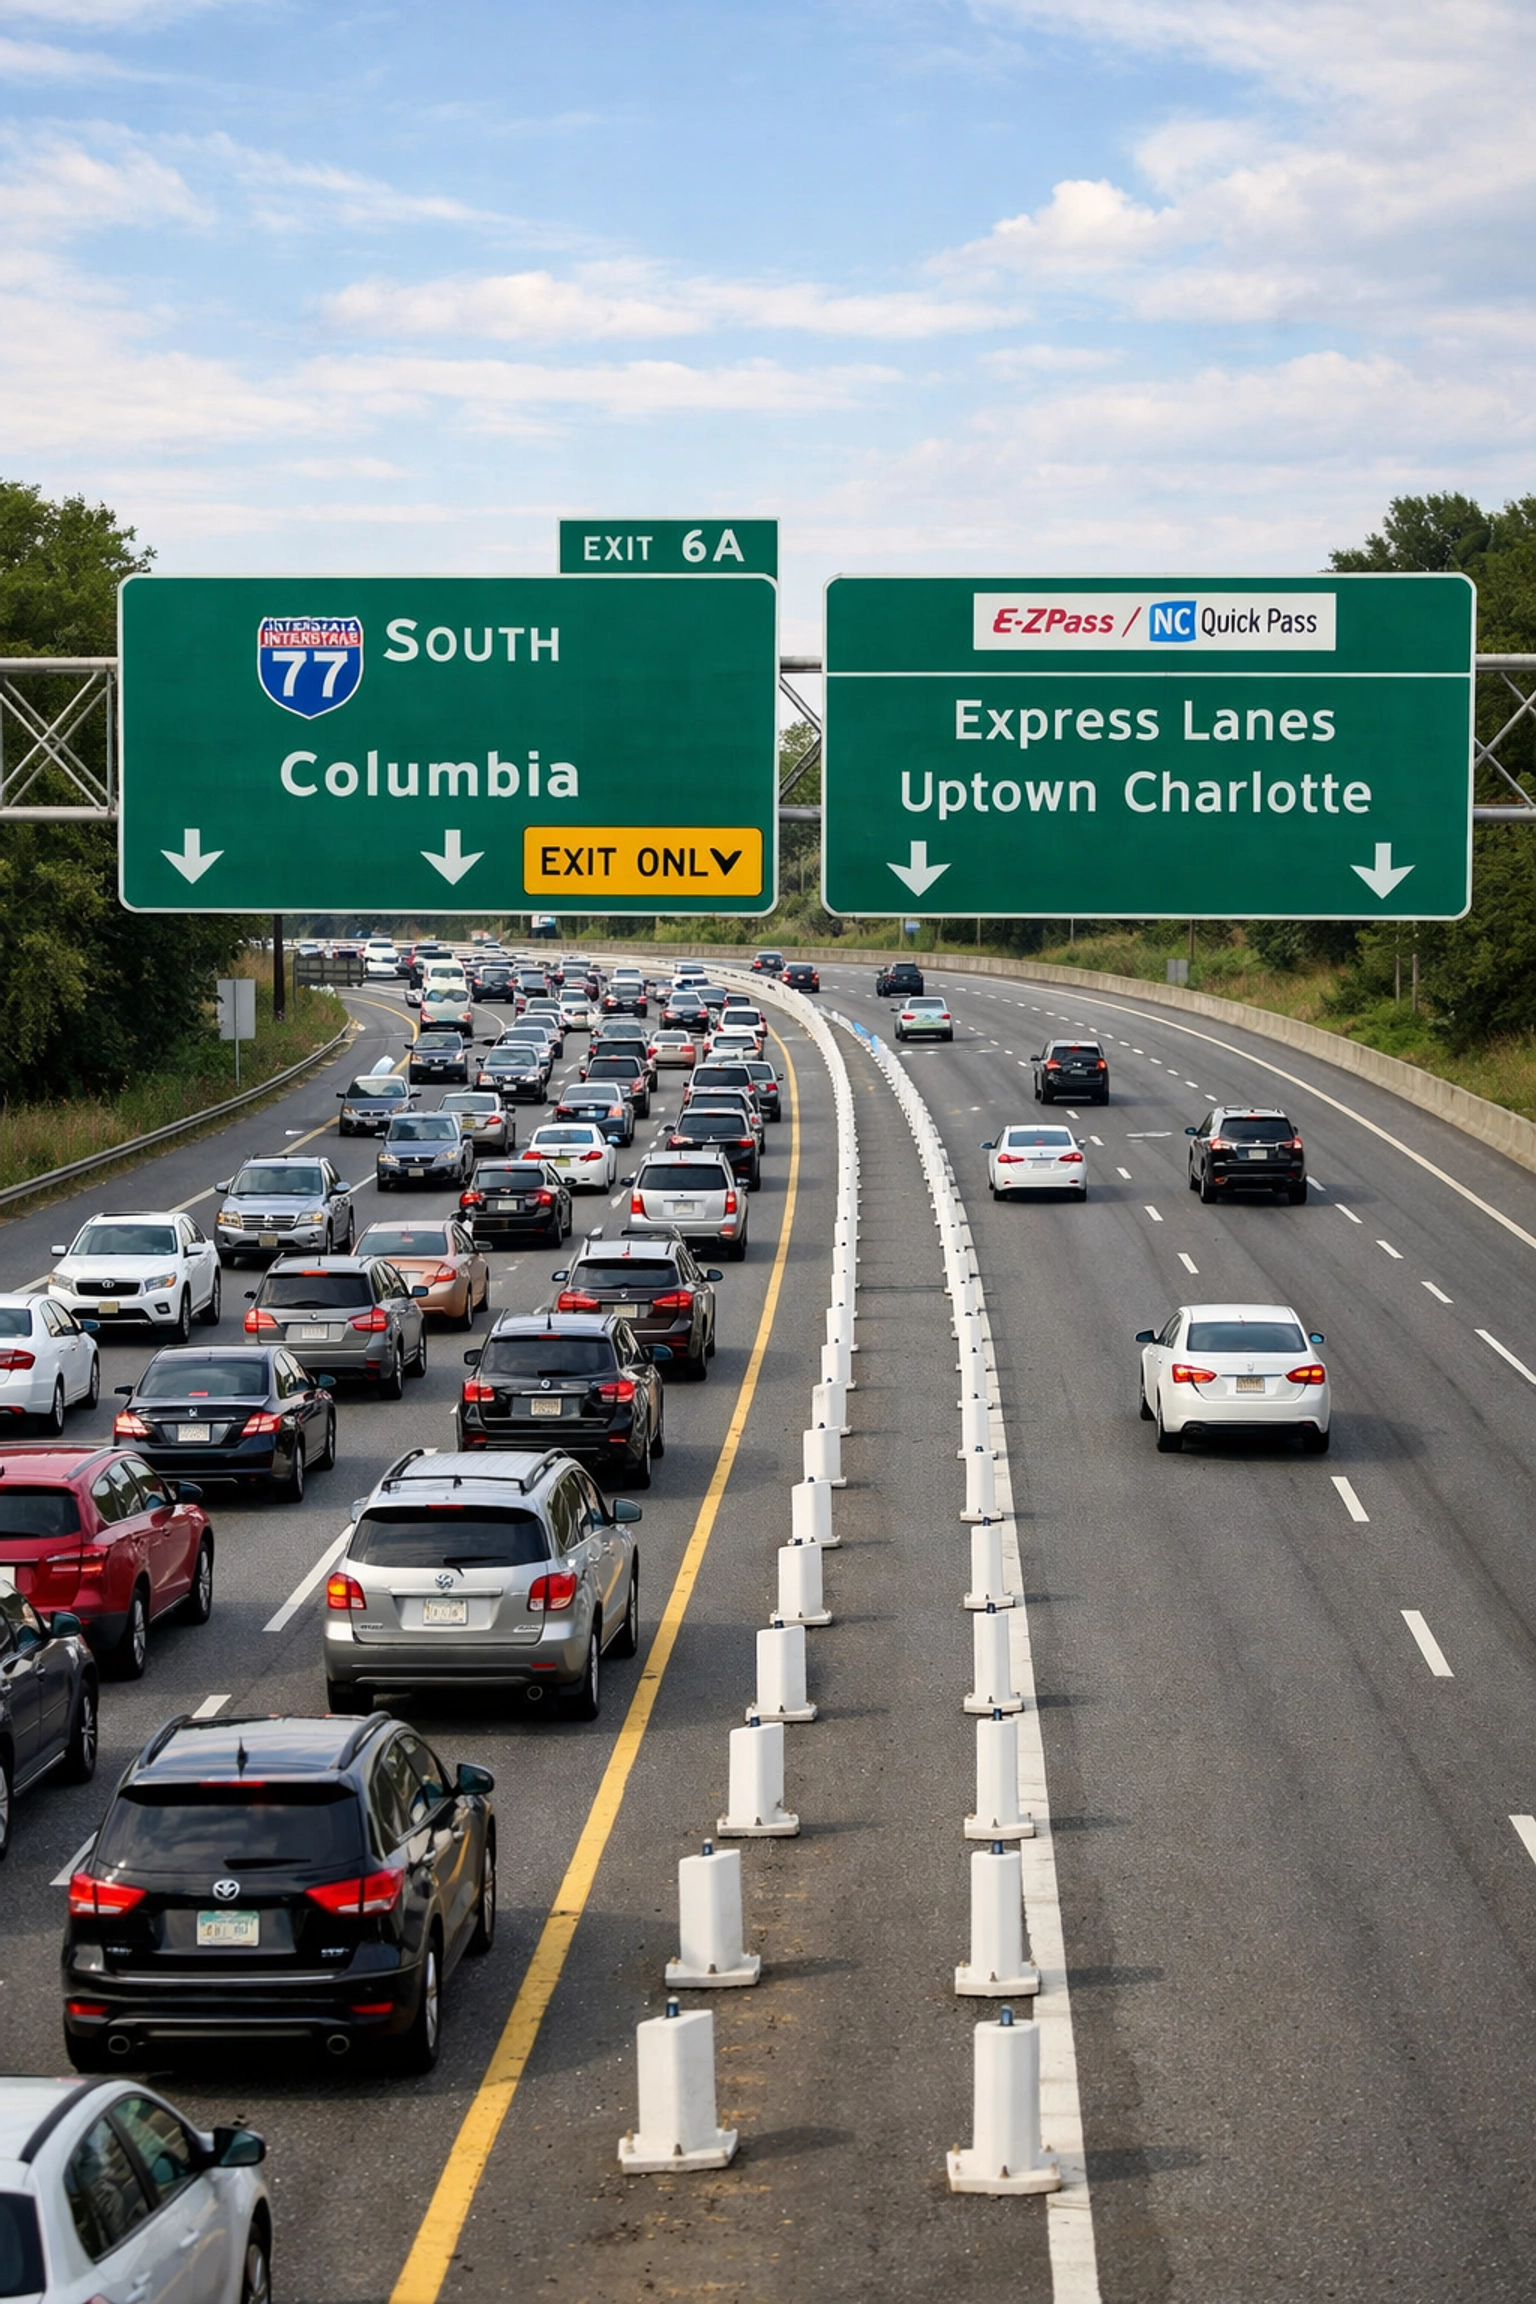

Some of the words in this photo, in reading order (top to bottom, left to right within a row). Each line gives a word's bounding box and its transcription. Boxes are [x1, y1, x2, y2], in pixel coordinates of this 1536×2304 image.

[584, 535, 653, 561] EXIT
[682, 529, 745, 562] 6A
[383, 618, 559, 662] SOUTH
[992, 608, 1114, 634] E-ZPass
[1154, 608, 1191, 635] NC
[1201, 608, 1261, 638] Quick
[1267, 608, 1317, 633] Pass
[272, 650, 348, 698] 77
[955, 699, 1160, 750] Express
[1184, 700, 1336, 742] Lanes
[280, 750, 579, 798] Columbia
[901, 771, 1096, 821] Uptown
[1124, 770, 1372, 814] Charlotte
[541, 846, 617, 876] EXIT
